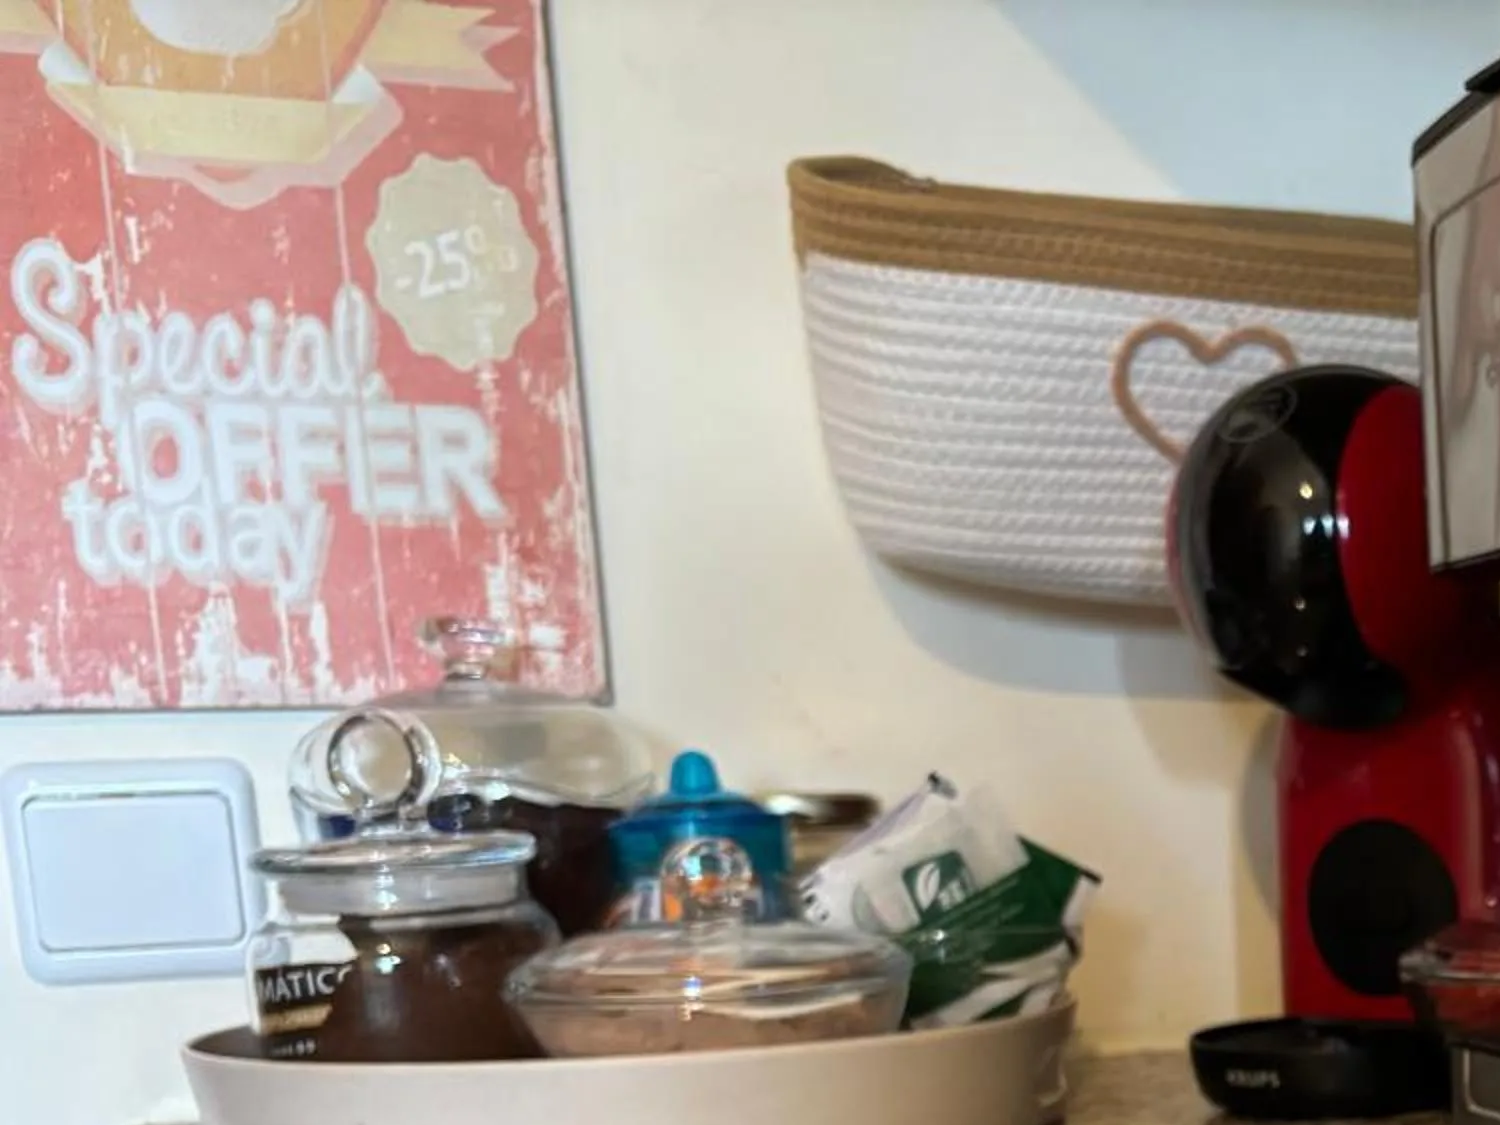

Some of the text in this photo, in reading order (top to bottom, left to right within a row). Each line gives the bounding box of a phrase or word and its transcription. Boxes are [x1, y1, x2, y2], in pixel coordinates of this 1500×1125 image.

[10, 238, 386, 430] Special
[118, 398, 506, 522] OFFER
[62, 476, 332, 606] today
